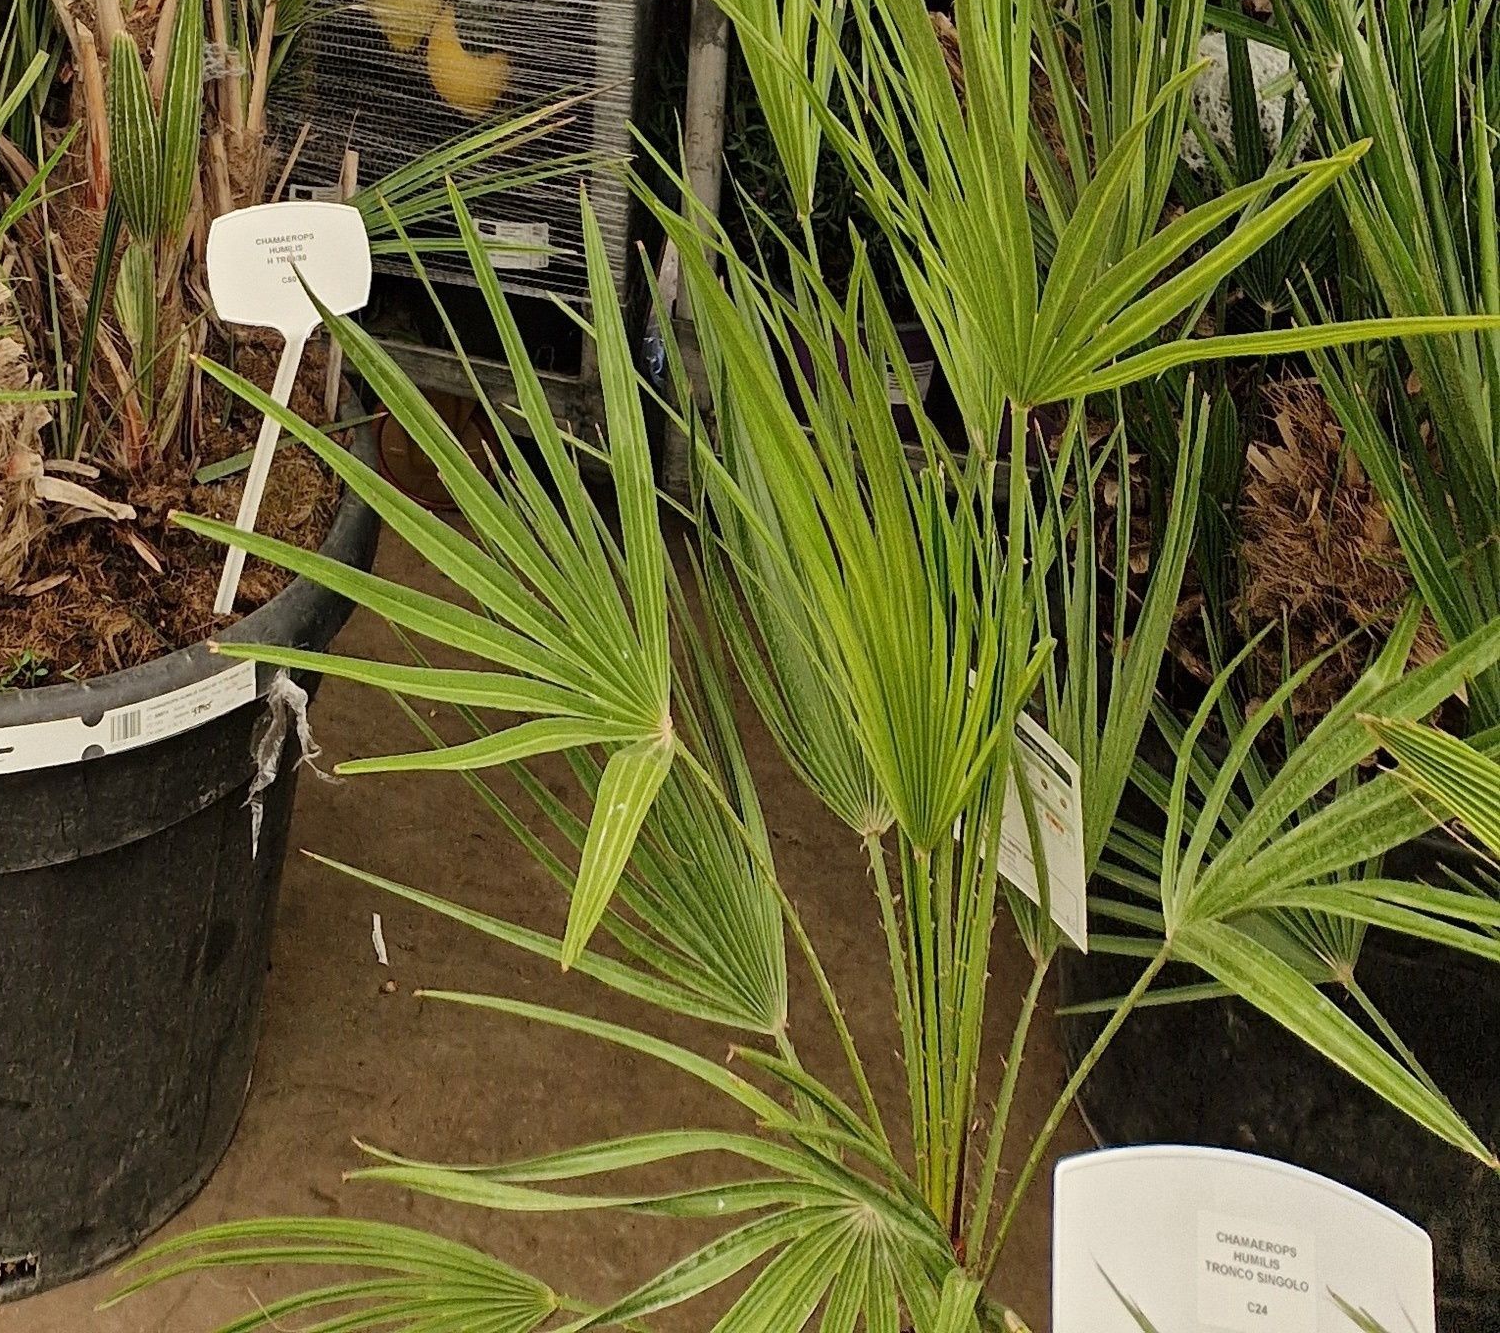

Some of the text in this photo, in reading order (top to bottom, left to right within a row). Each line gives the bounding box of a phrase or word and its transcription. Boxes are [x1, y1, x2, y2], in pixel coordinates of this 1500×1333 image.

[255, 233, 314, 245] CHAMAEROPS
[1216, 1232, 1297, 1258] CHAMAEROPS
[1233, 1252, 1280, 1270] HUMILIS
[1204, 1260, 1309, 1293] TRONCO SINGOLO
[1246, 1301, 1268, 1315] C24
